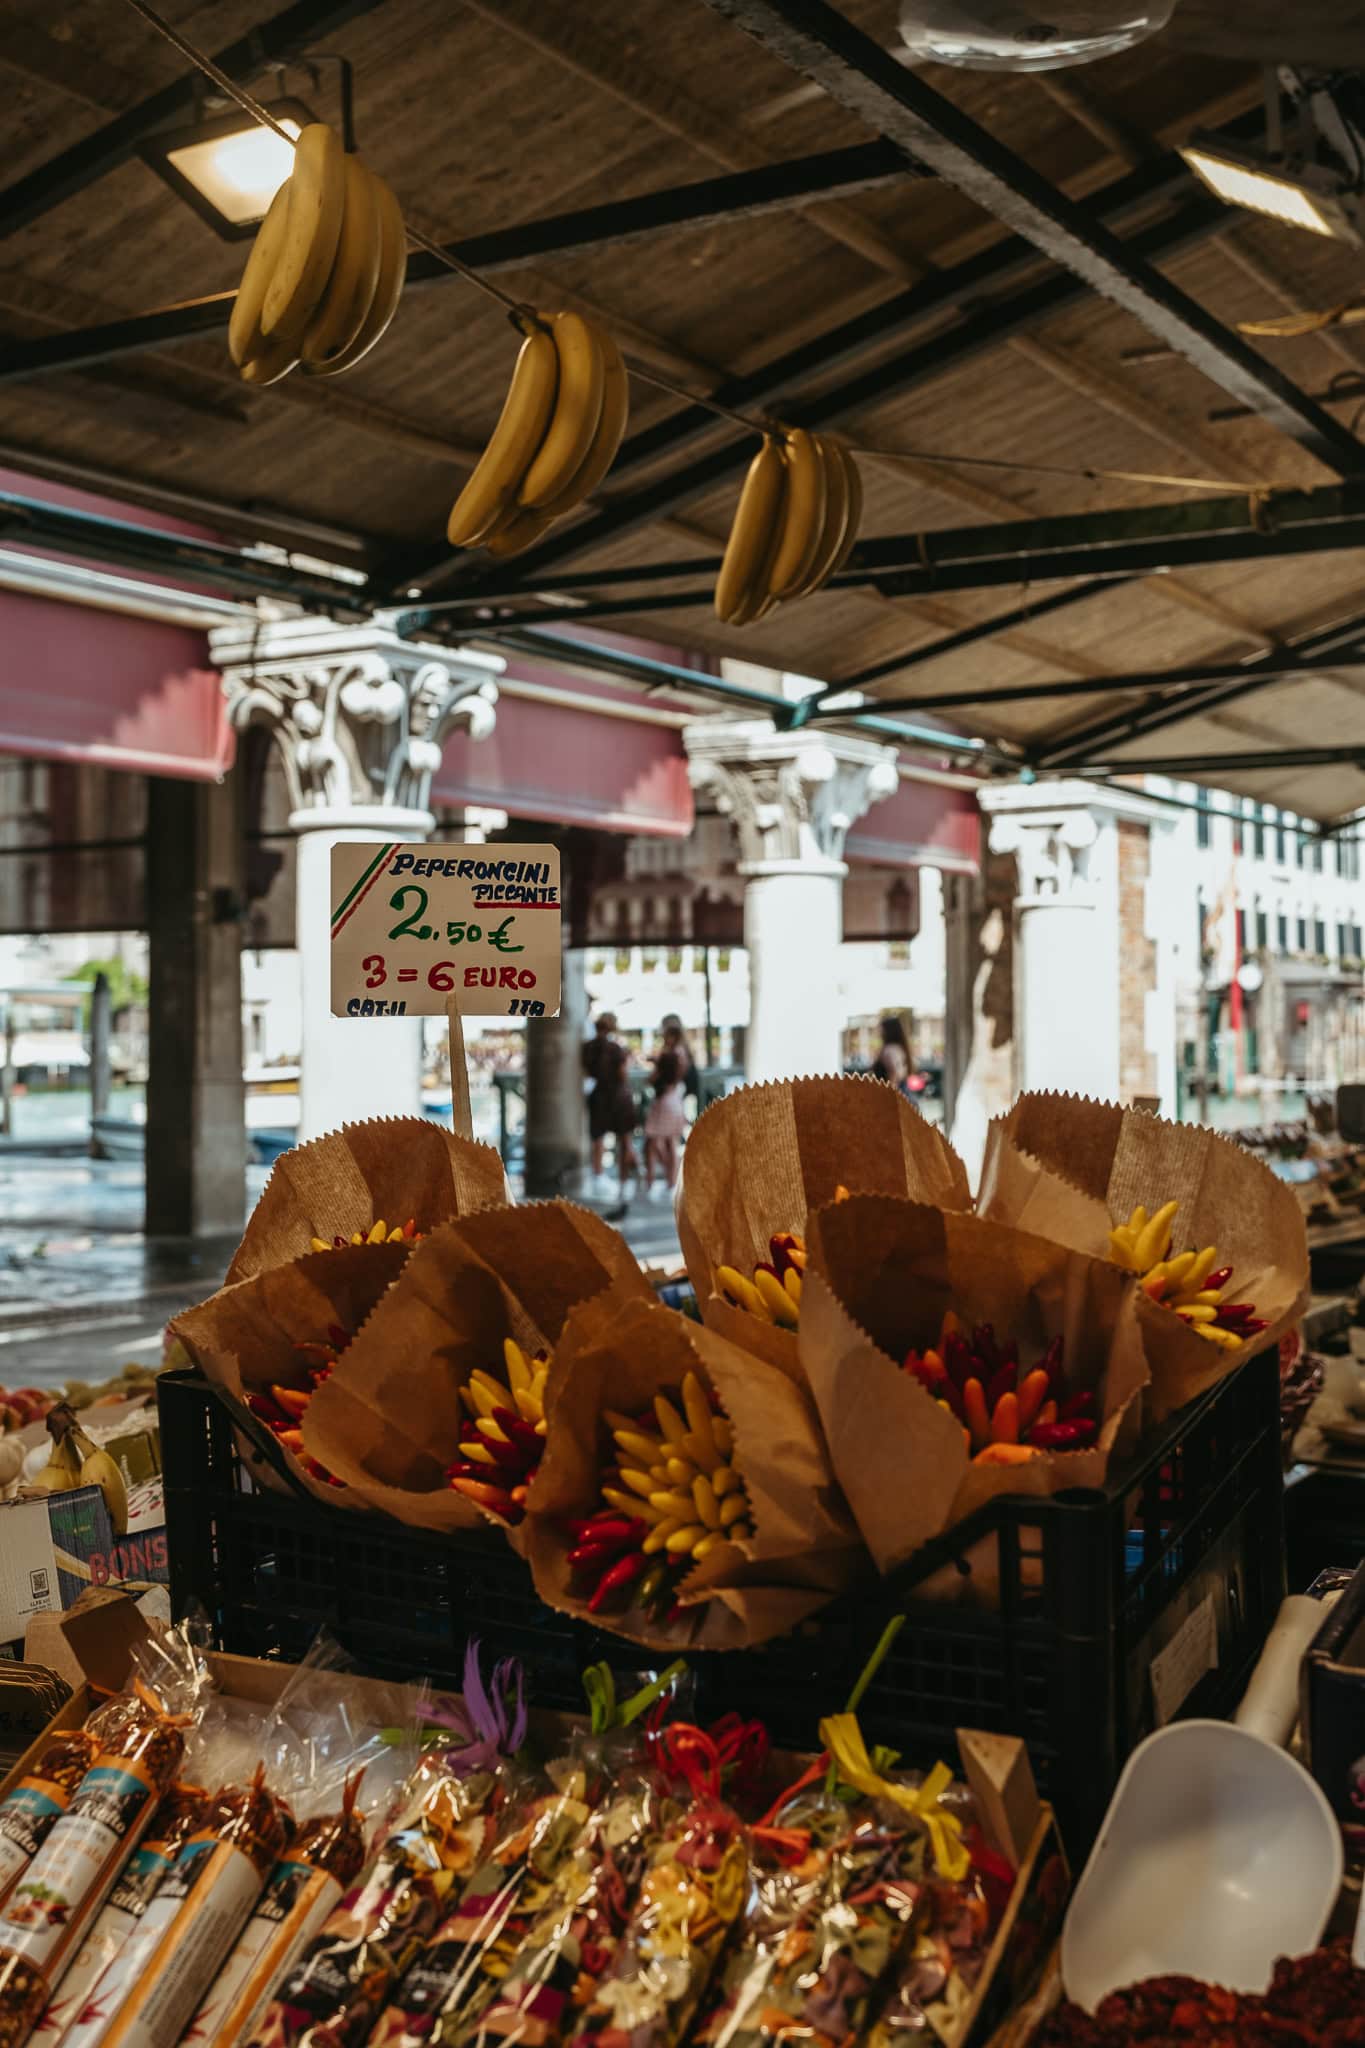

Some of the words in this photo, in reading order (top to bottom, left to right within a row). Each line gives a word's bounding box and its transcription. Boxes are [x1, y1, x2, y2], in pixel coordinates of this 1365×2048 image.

[389, 854, 550, 884] PEPERONCINI
[471, 884, 558, 903] PICCANTE
[362, 955, 387, 988] 3
[428, 961, 455, 992] 6
[463, 966, 537, 990] EURO
[89, 1535, 168, 1586] BONS
